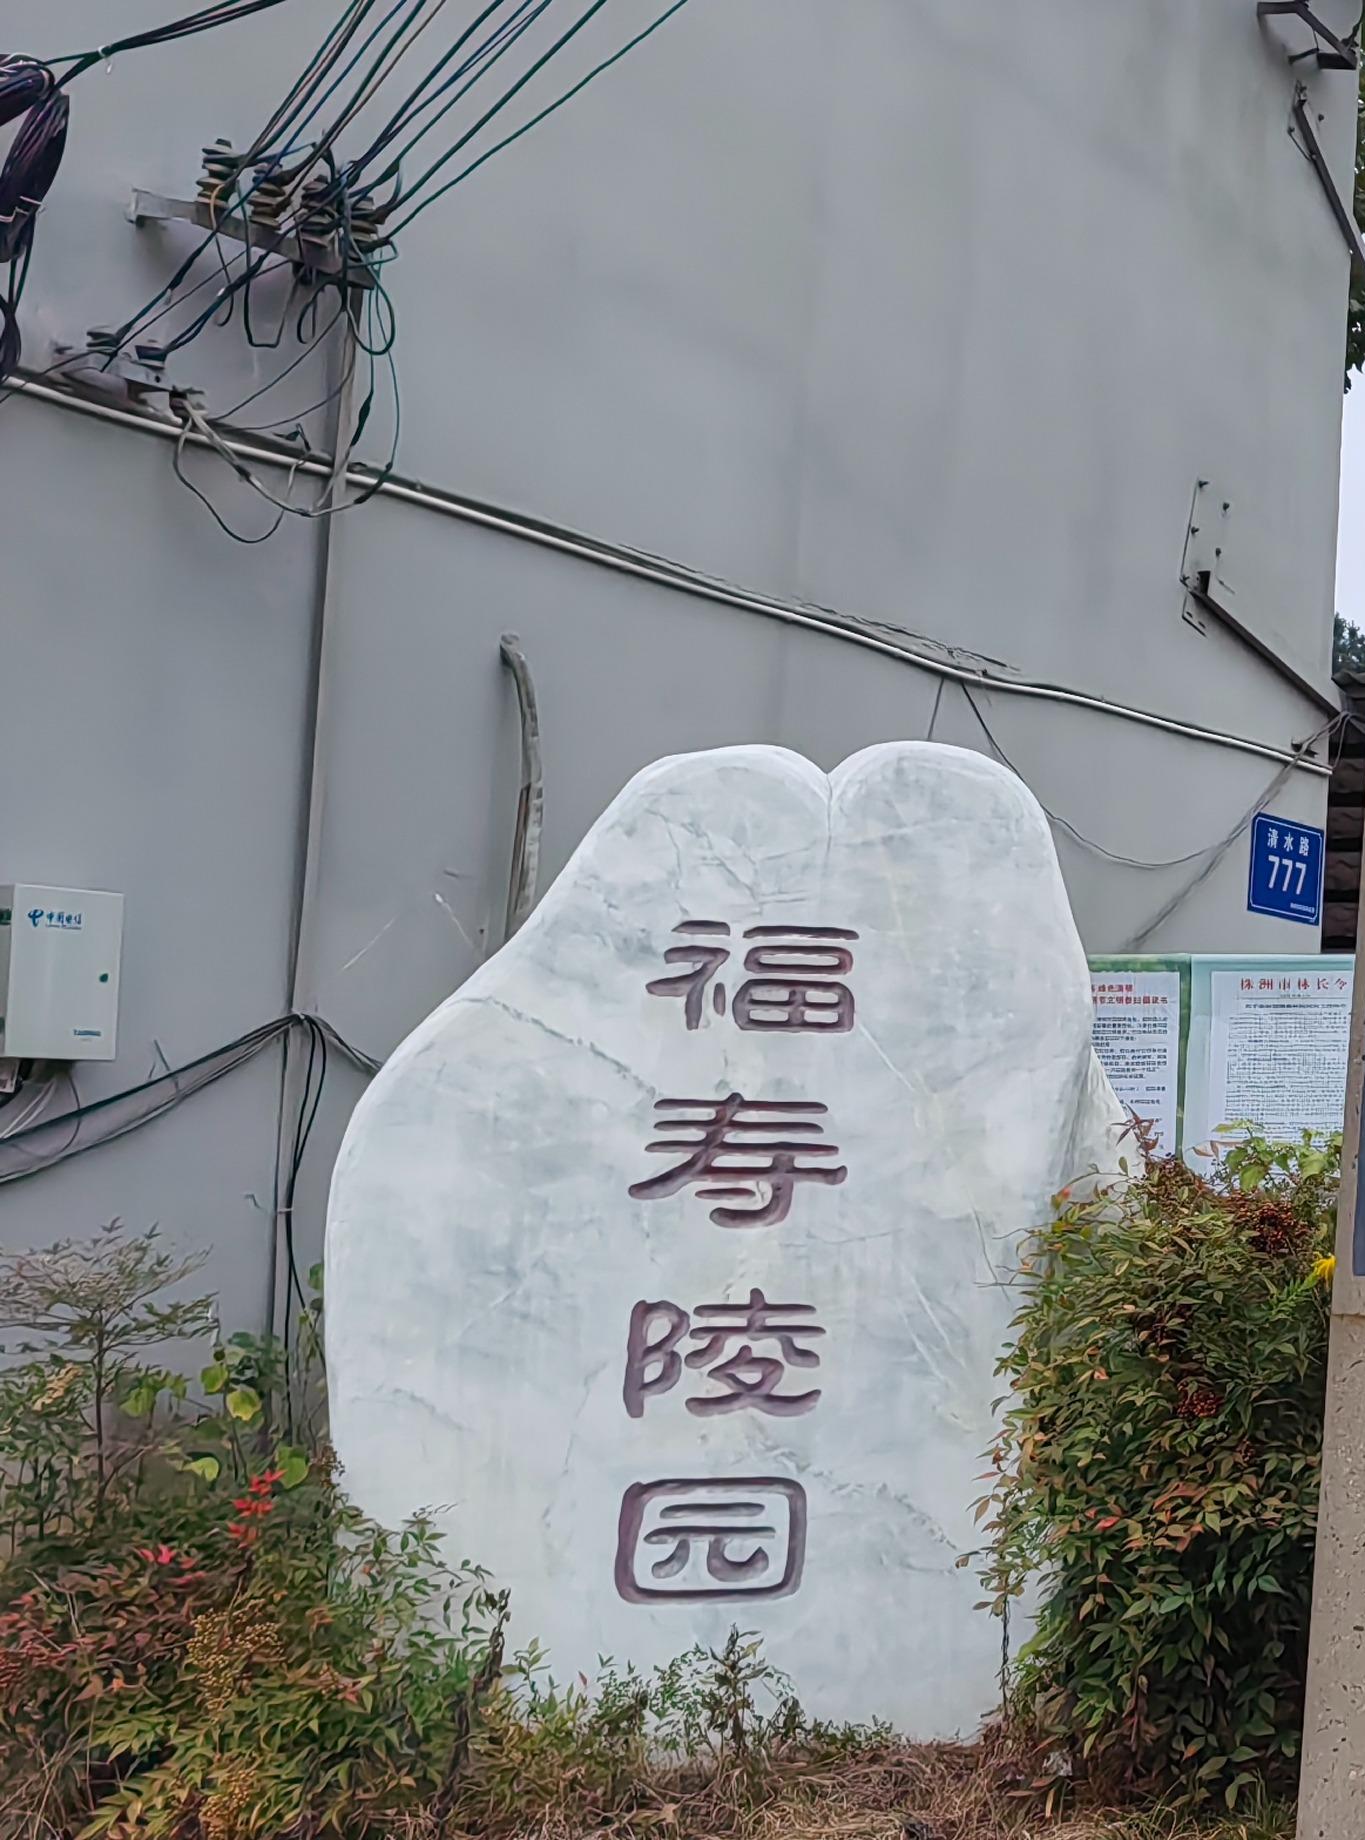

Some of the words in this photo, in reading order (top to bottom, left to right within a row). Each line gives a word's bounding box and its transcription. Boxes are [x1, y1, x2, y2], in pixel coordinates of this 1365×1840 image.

[1267, 827, 1310, 856] 清水路
[1268, 855, 1307, 895] 777
[615, 919, 860, 1605] 福寿陵园
